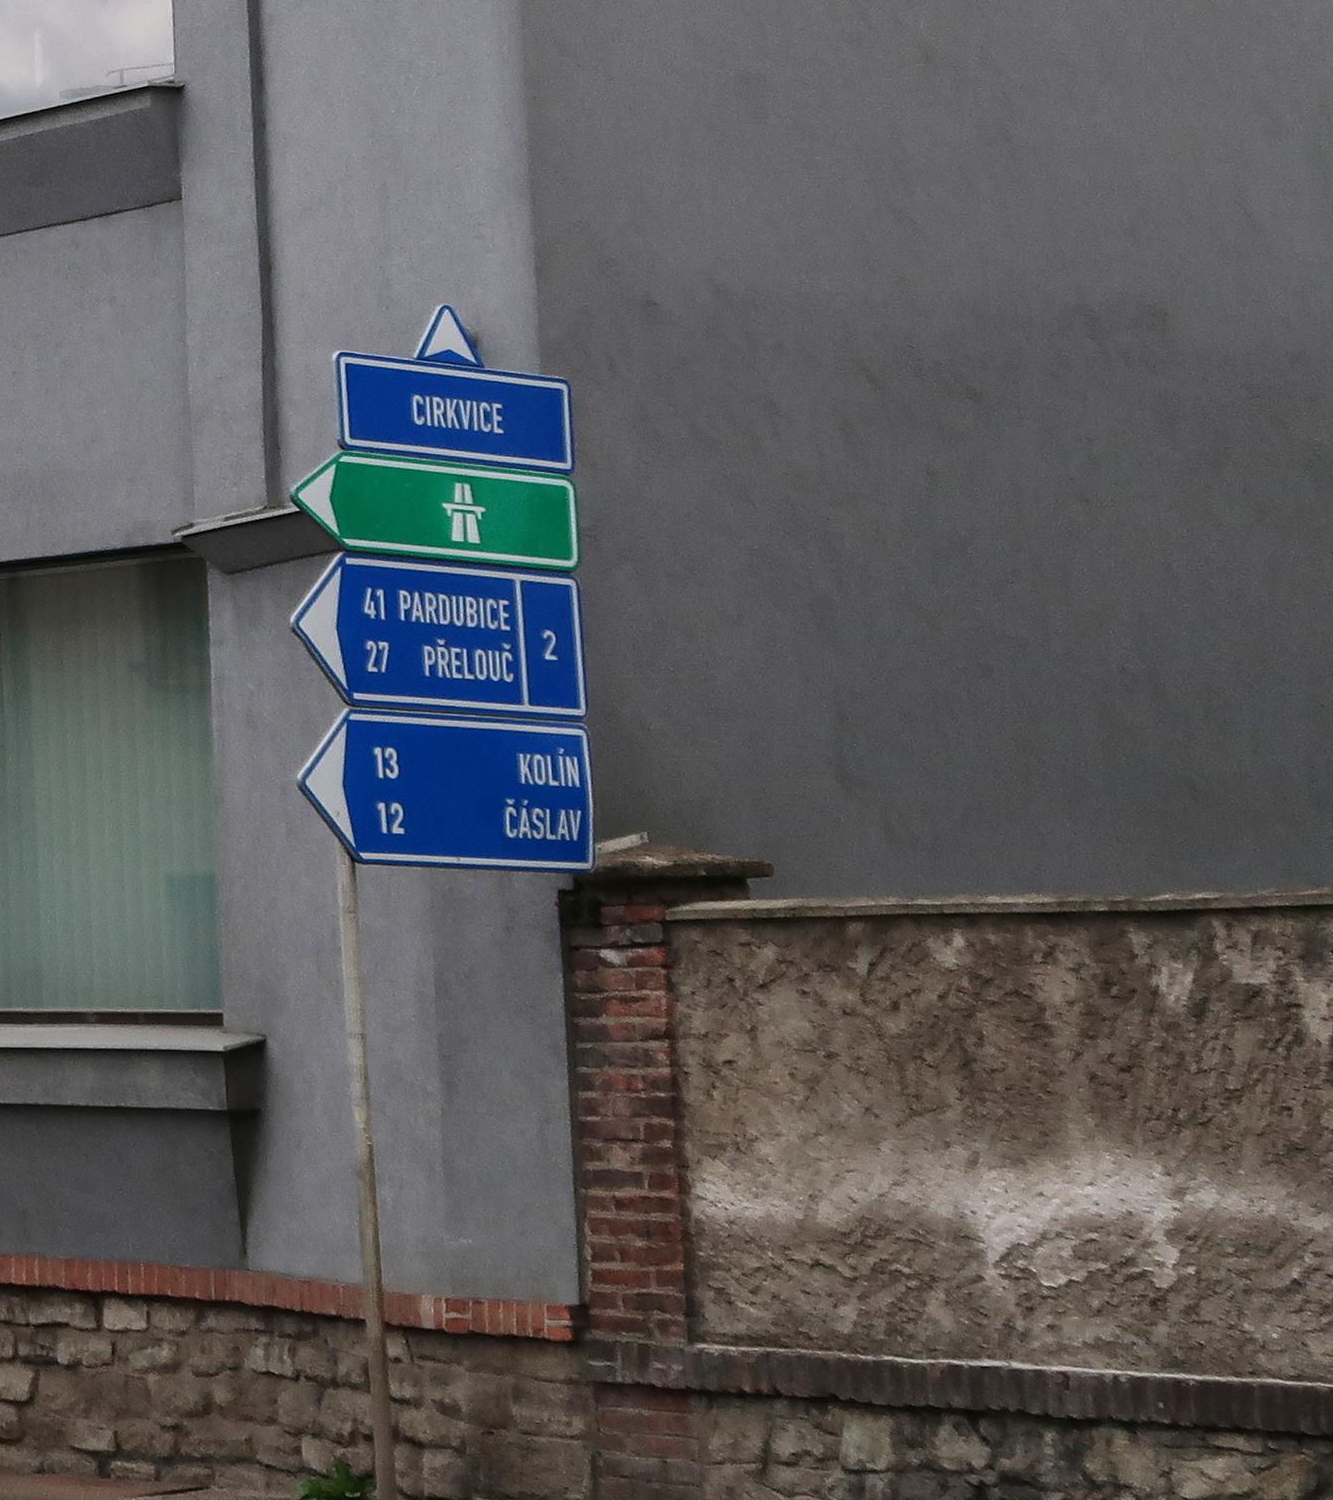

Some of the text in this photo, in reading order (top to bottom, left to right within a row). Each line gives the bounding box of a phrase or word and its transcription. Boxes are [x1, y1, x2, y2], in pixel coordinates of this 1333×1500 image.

[412, 394, 505, 434] CIRKVICE
[364, 587, 511, 631] 41 PARDUBICE
[367, 638, 514, 682] 27 PŘELOUČ
[542, 629, 559, 661] 2
[373, 747, 581, 788] 13 KOLÍN
[377, 798, 582, 841] 12 ČÁSLAV
